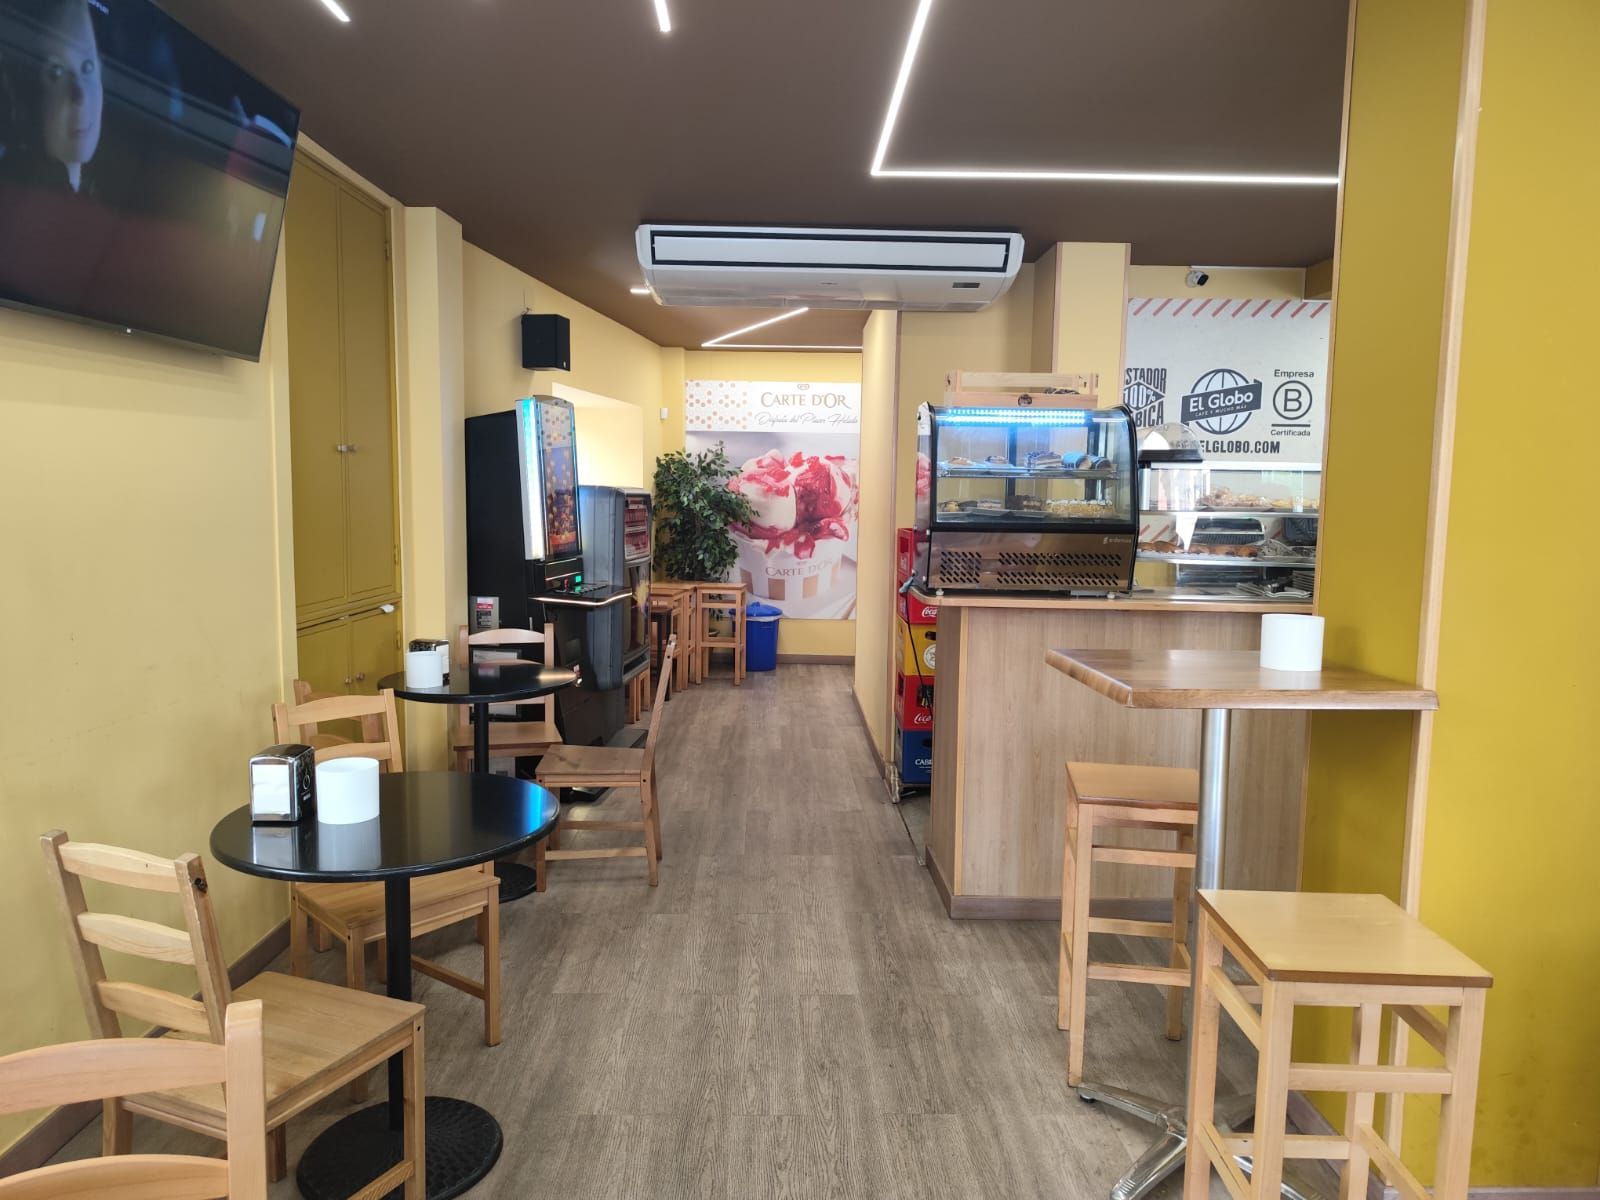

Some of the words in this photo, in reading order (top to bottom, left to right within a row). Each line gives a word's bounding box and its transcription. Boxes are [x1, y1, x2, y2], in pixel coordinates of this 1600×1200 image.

[1274, 369, 1315, 379] Empresa
[760, 391, 806, 408] CARTE
[1124, 384, 1157, 408] 100%
[1208, 390, 1254, 409] Globo
[1283, 388, 1303, 412] B
[1270, 429, 1311, 437] Certificada
[765, 566, 803, 577] CARTE
